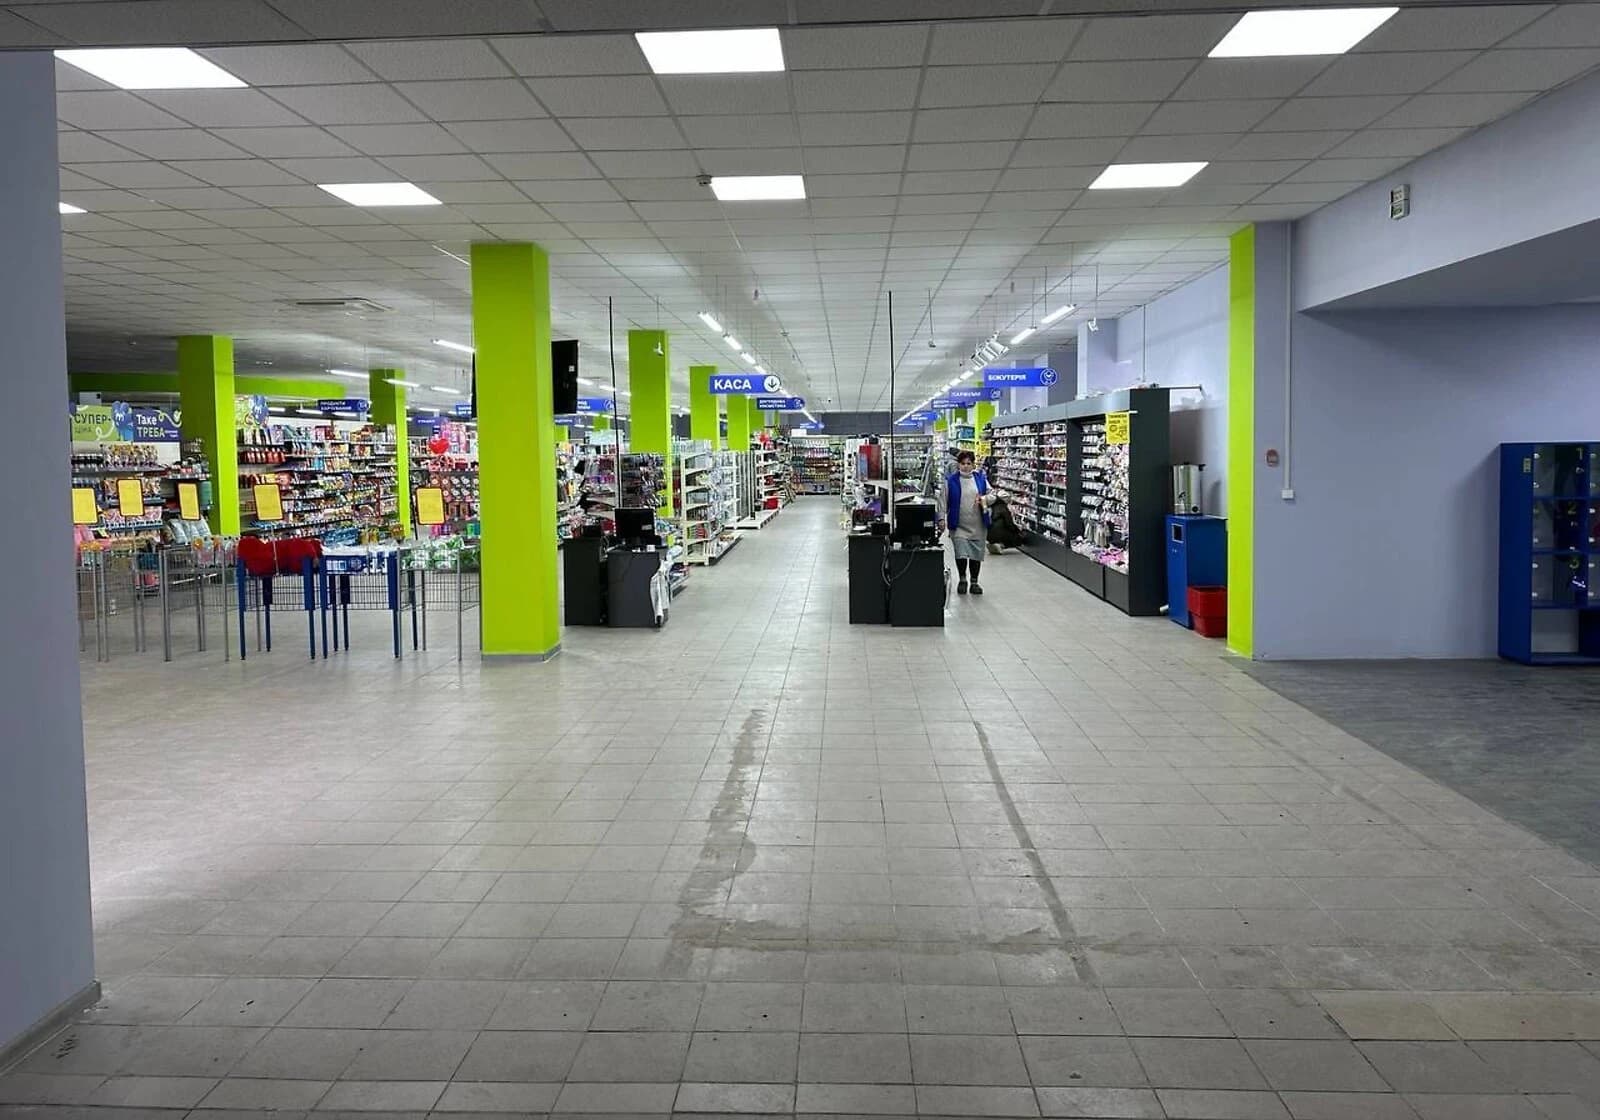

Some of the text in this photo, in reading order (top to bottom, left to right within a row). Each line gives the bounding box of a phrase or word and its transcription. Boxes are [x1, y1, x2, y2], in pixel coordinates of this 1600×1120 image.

[714, 378, 752, 390] КАСА
[74, 413, 112, 425] СУПЕР-
[136, 414, 157, 425] Таке
[136, 427, 165, 438] ТРЕБА
